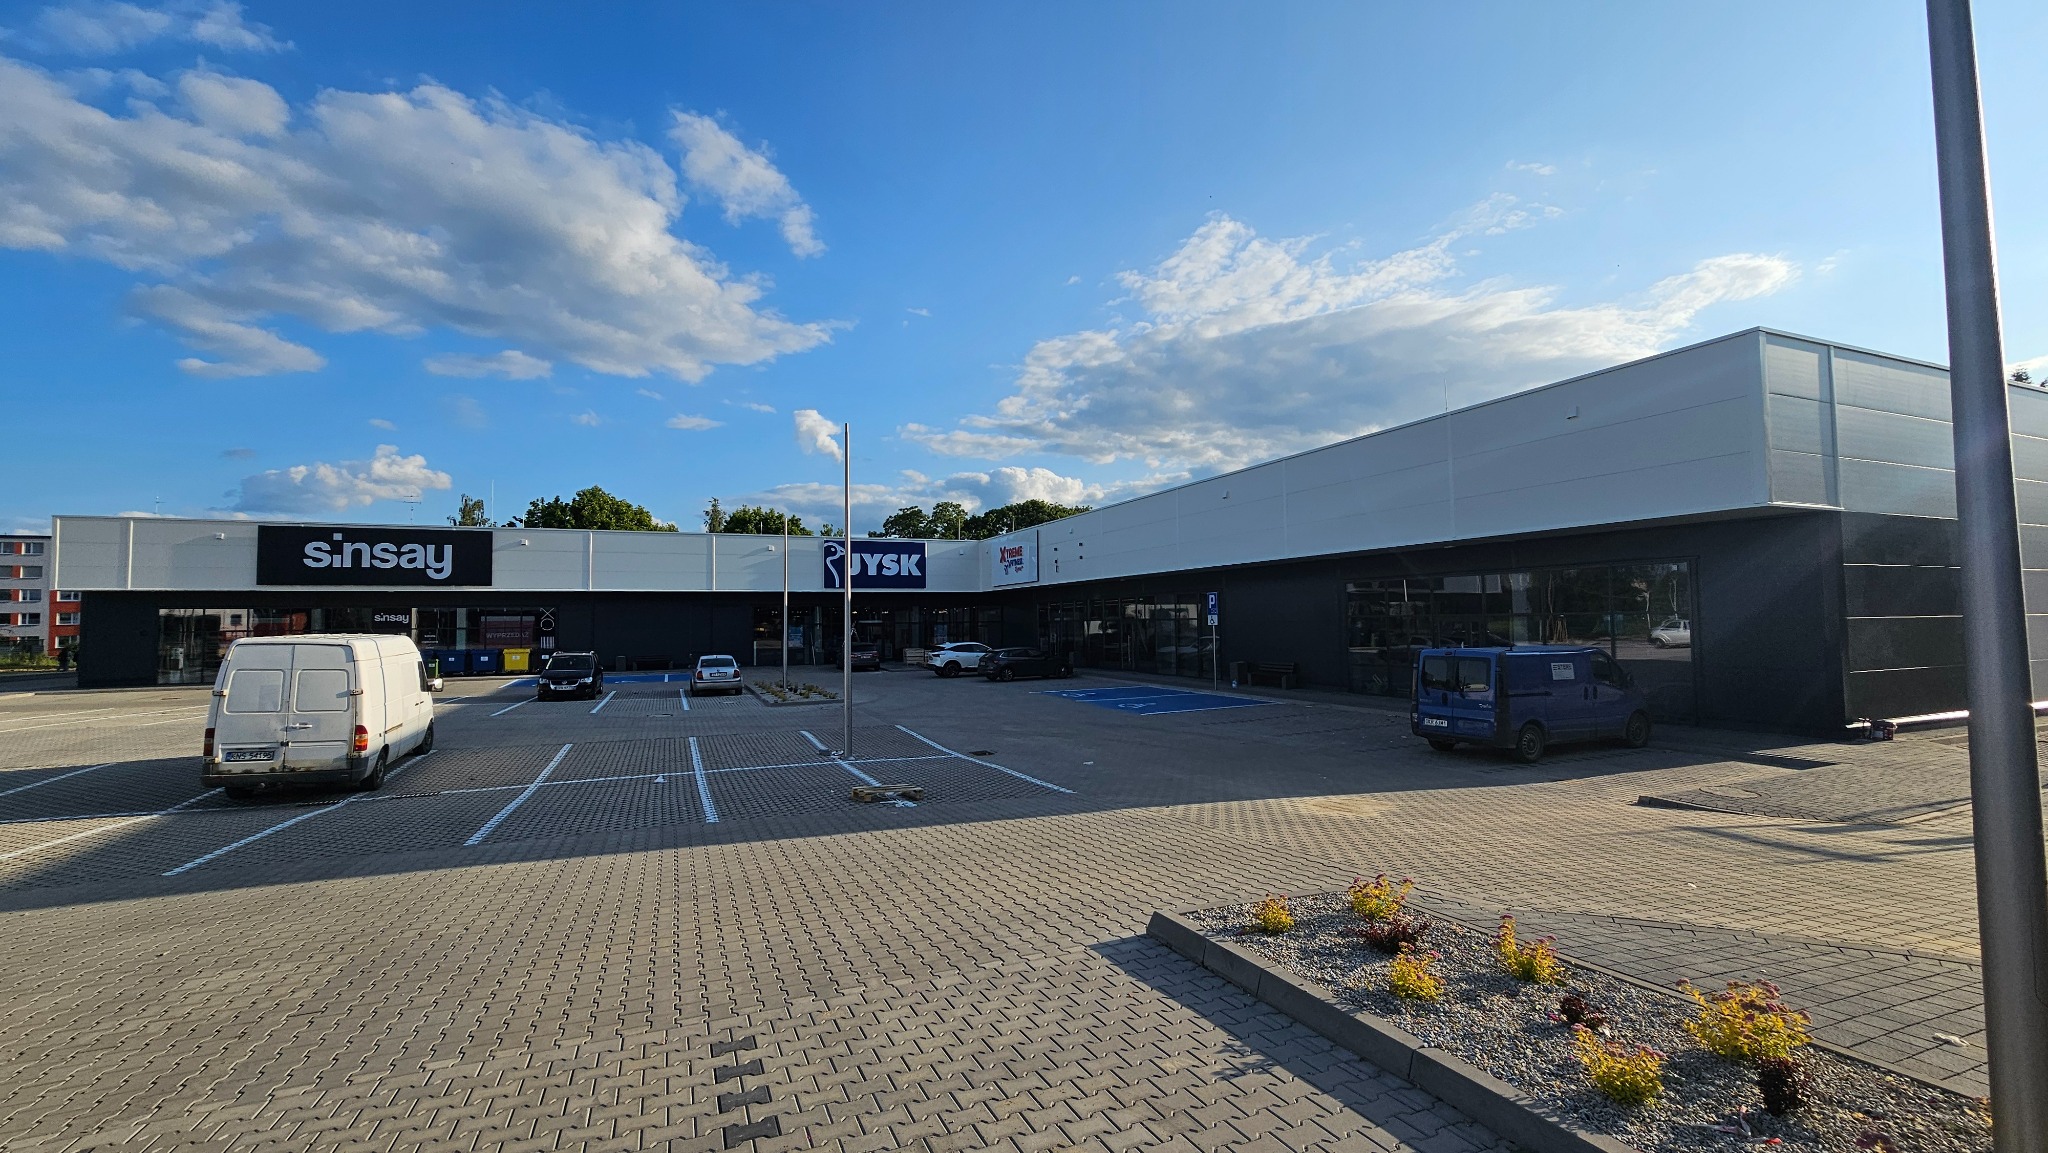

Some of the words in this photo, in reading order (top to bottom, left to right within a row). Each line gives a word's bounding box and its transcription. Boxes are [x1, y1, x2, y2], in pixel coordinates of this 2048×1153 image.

[303, 532, 453, 580] sinsay
[850, 553, 922, 576] JYSK
[1208, 594, 1215, 608] P
[374, 612, 410, 624] sinsay
